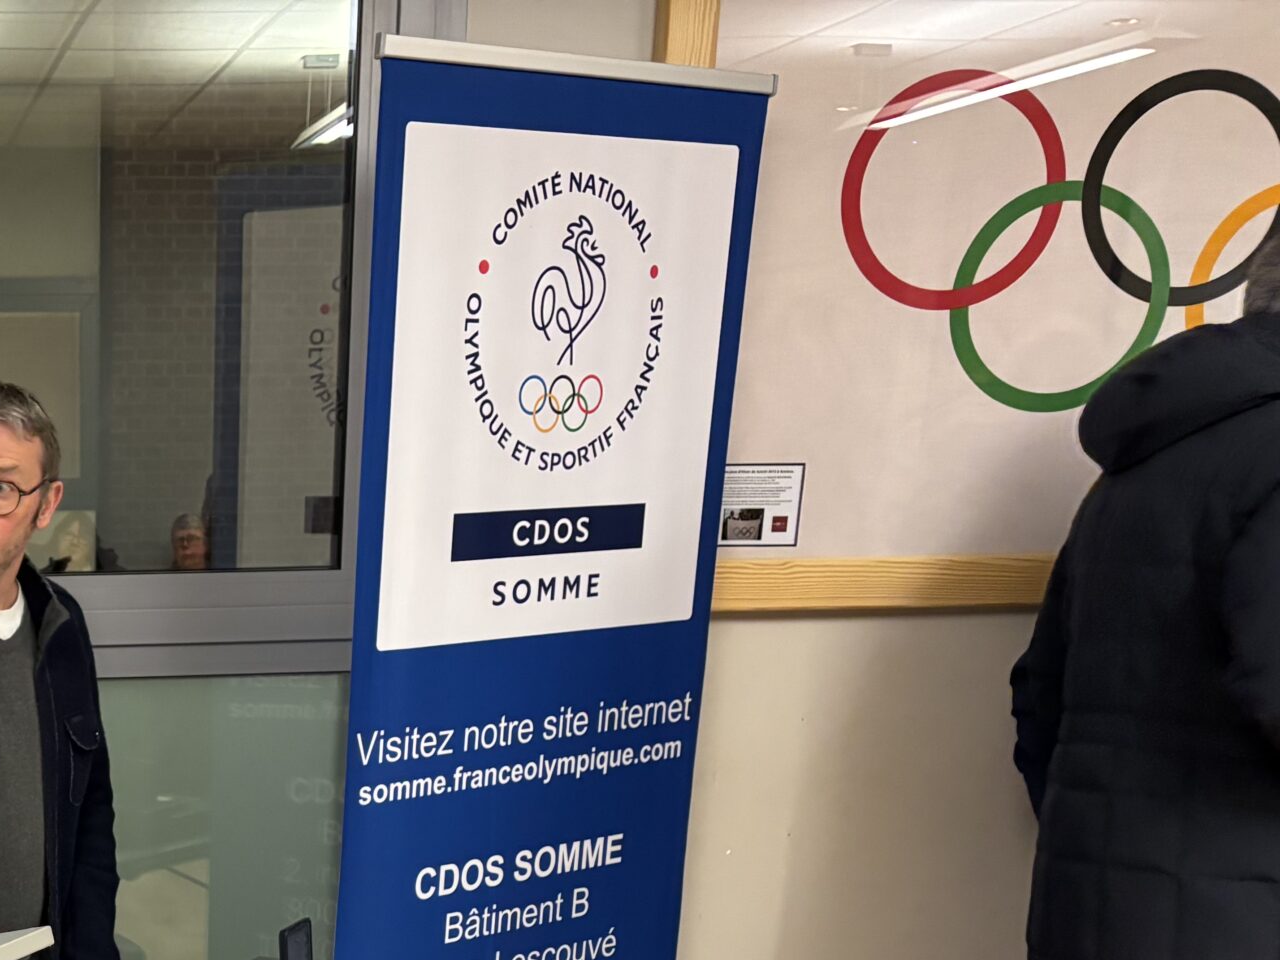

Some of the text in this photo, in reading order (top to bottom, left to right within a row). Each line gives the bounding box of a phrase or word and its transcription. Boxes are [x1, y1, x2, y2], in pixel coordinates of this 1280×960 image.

[492, 171, 651, 253] COMITÉ NATIONAL
[464, 292, 663, 472] OLYMPIQUE ET SPORTIF FRANÇAIS
[512, 516, 590, 547] CDOS
[492, 573, 600, 607] SOMME
[356, 691, 693, 766] Visitez notre site internet
[358, 737, 682, 806] somme.franceolympique.com
[414, 832, 624, 900] CDOS SOMME
[443, 886, 591, 945] Bâtiment B
